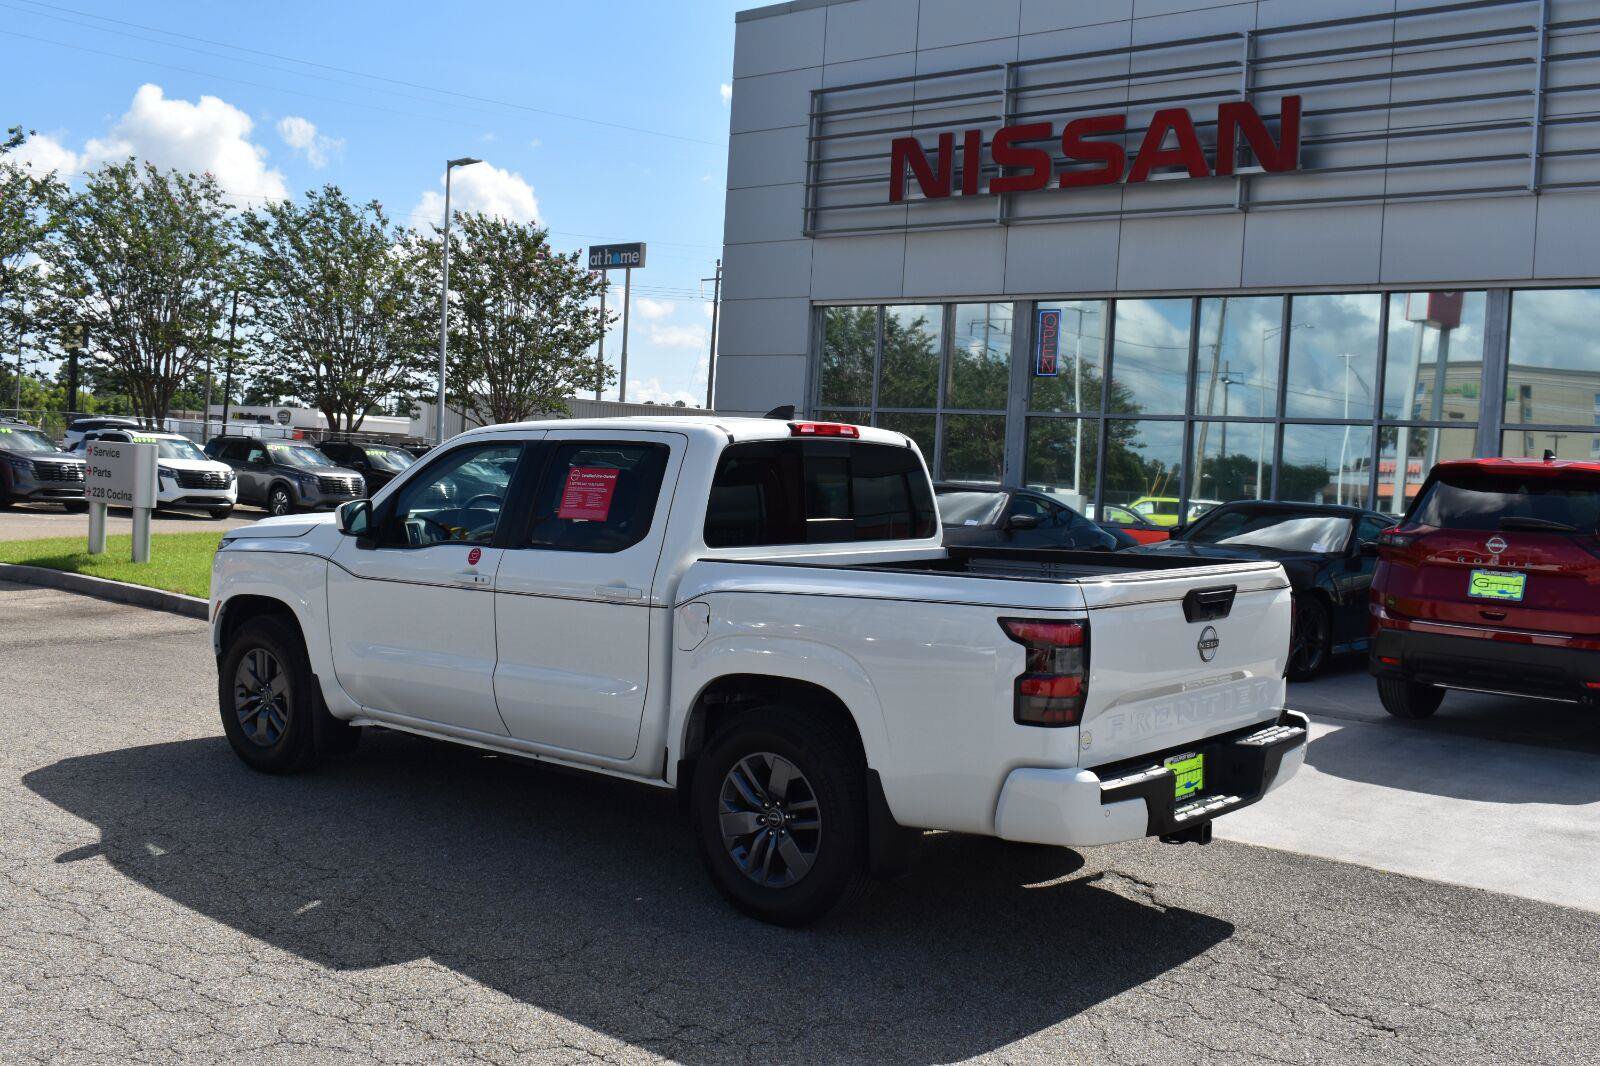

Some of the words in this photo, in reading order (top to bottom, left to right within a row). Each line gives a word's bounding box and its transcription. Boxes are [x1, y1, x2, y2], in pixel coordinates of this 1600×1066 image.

[889, 95, 1302, 201] NISSAN
[590, 252, 602, 266] at
[1042, 313, 1056, 373] OPEN
[93, 446, 120, 458] Service
[92, 466, 112, 478] Parts
[92, 487, 104, 499] 228
